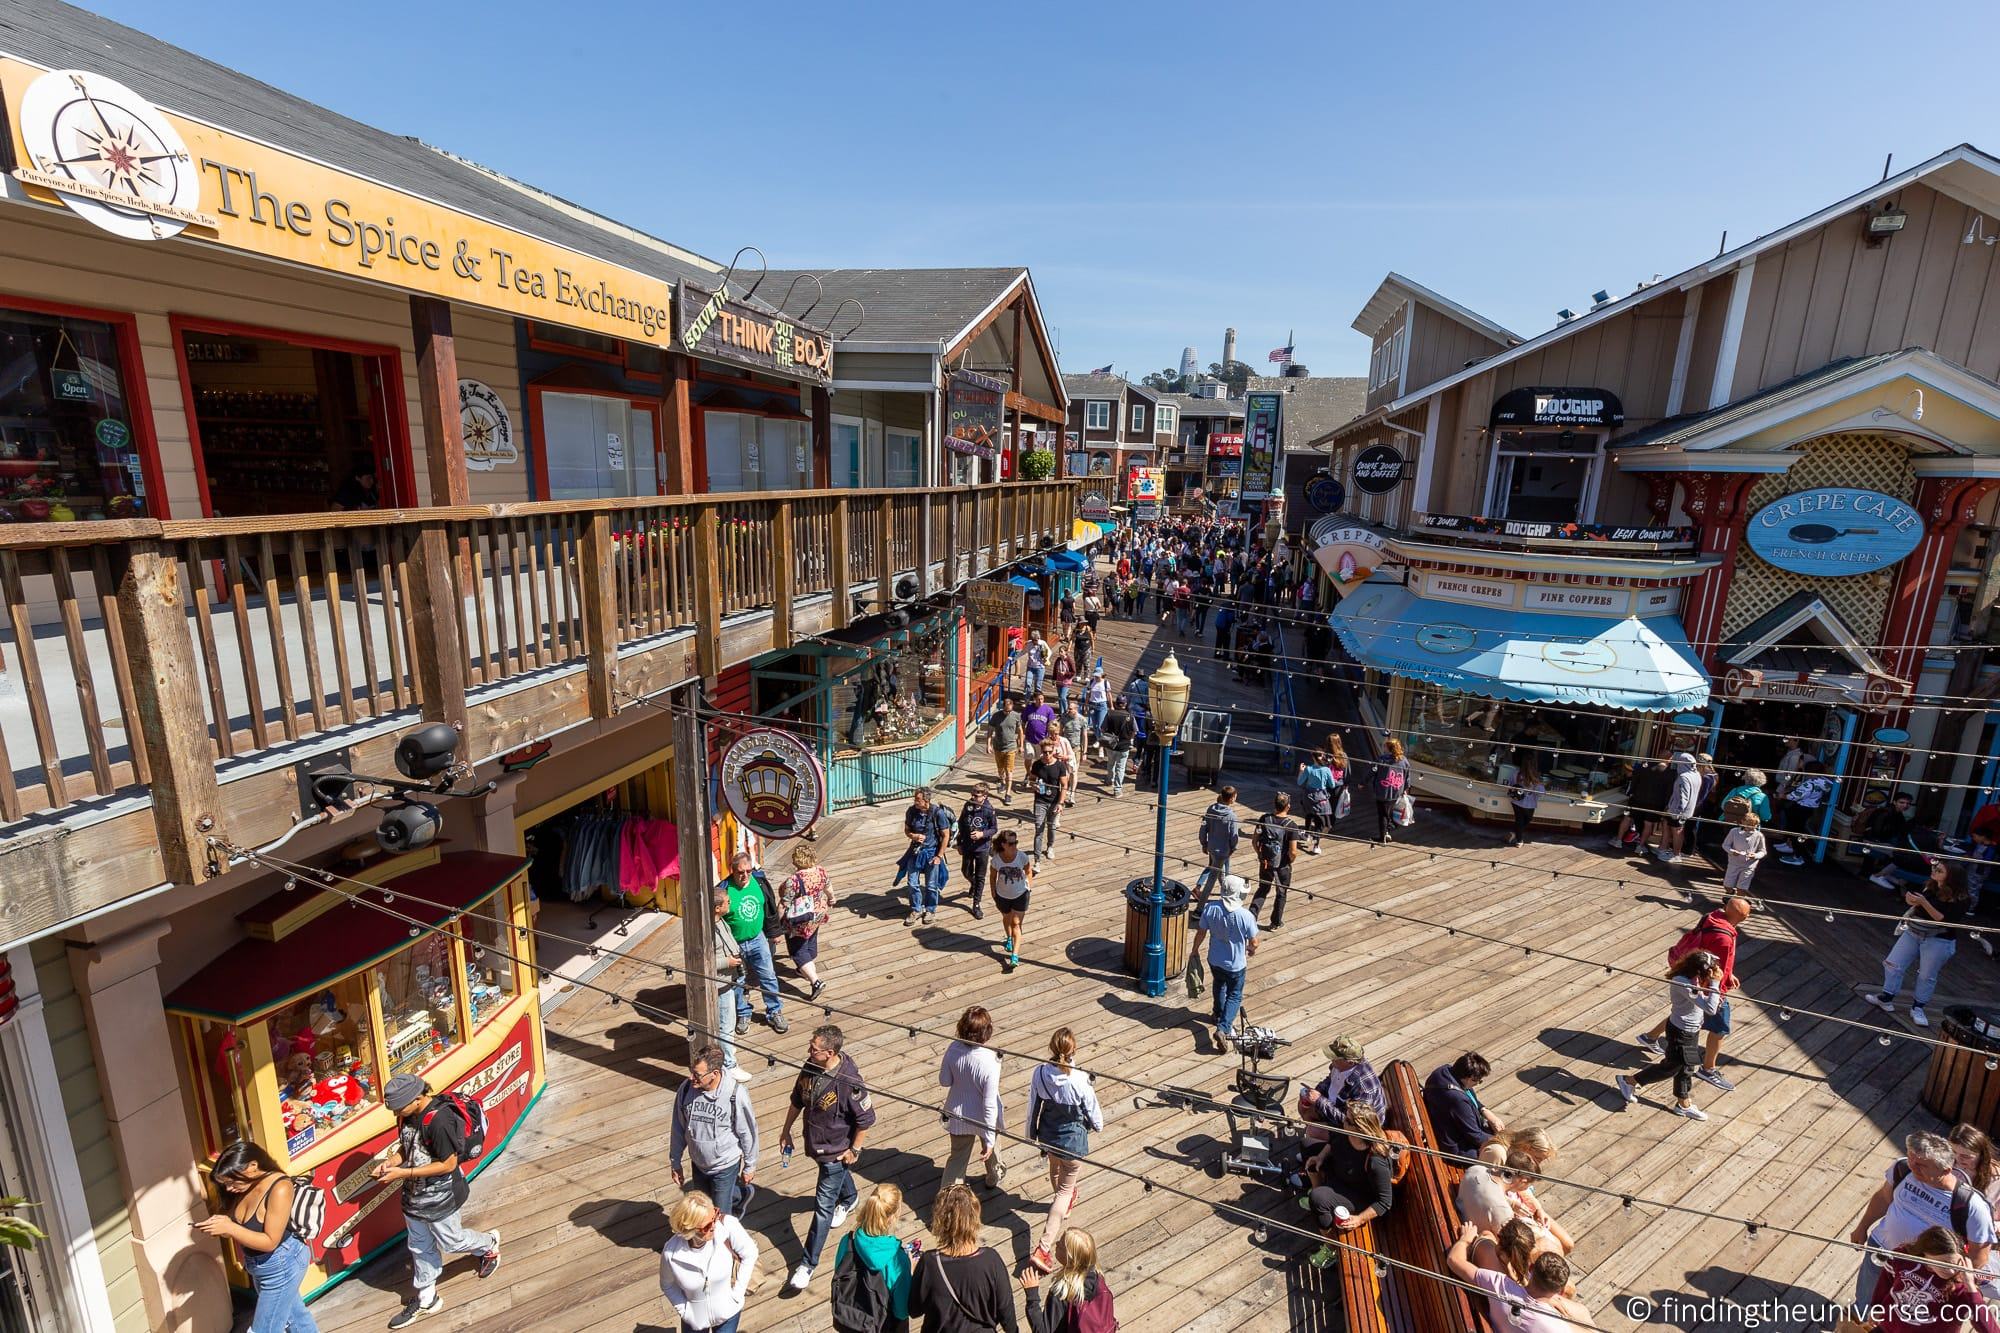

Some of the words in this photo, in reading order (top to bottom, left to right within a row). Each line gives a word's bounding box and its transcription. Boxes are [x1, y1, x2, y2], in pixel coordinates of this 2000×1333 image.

[22, 169, 65, 190] Purveyors
[67, 182, 76, 192] of
[79, 185, 97, 196] Fine
[99, 187, 126, 204] Spices,
[127, 191, 152, 210] Herbs,
[153, 203, 179, 217] Blends,
[180, 209, 199, 223] Salts,
[200, 214, 216, 226] Teas
[200, 157, 312, 236] The
[325, 199, 440, 270] Spice
[453, 239, 482, 282] &
[490, 247, 547, 299] Tea
[555, 266, 667, 337] Exchange
[685, 304, 718, 349] SOLVE
[718, 310, 774, 355] THINK
[775, 320, 794, 338] OUT
[186, 343, 241, 361] BLENDS
[778, 336, 791, 351] OF
[775, 350, 793, 367] THE
[62, 382, 87, 395] Open
[1536, 398, 1604, 415] DOUGHP
[1534, 414, 1554, 422] LEGIT
[1556, 415, 1577, 423] COOKIE
[1355, 470, 1370, 478] AND
[1371, 470, 1399, 479] COFFEE!
[1356, 461, 1377, 470] COOKIE
[1379, 462, 1401, 471] DOUGH
[1437, 517, 1459, 527] DOUGH
[1505, 522, 1551, 537] DOUGHP
[1320, 530, 1384, 549] CREPES
[1612, 528, 1638, 539] LEGIT
[1772, 547, 1826, 560] FRENCH
[1438, 581, 1468, 593] FRENCH
[1471, 584, 1503, 597] CREPES
[1540, 592, 1564, 604] FINE
[1568, 593, 1612, 606] COFFEES
[1556, 687, 1608, 699] LUNCH
[461, 1067, 495, 1095] CAR
[496, 1046, 520, 1074] STORE
[489, 1080, 522, 1107] CALIFORNIA
[1904, 1182, 1935, 1206] KEALOHA
[335, 1218, 358, 1238] SAN
[361, 1180, 403, 1216] FRANC
